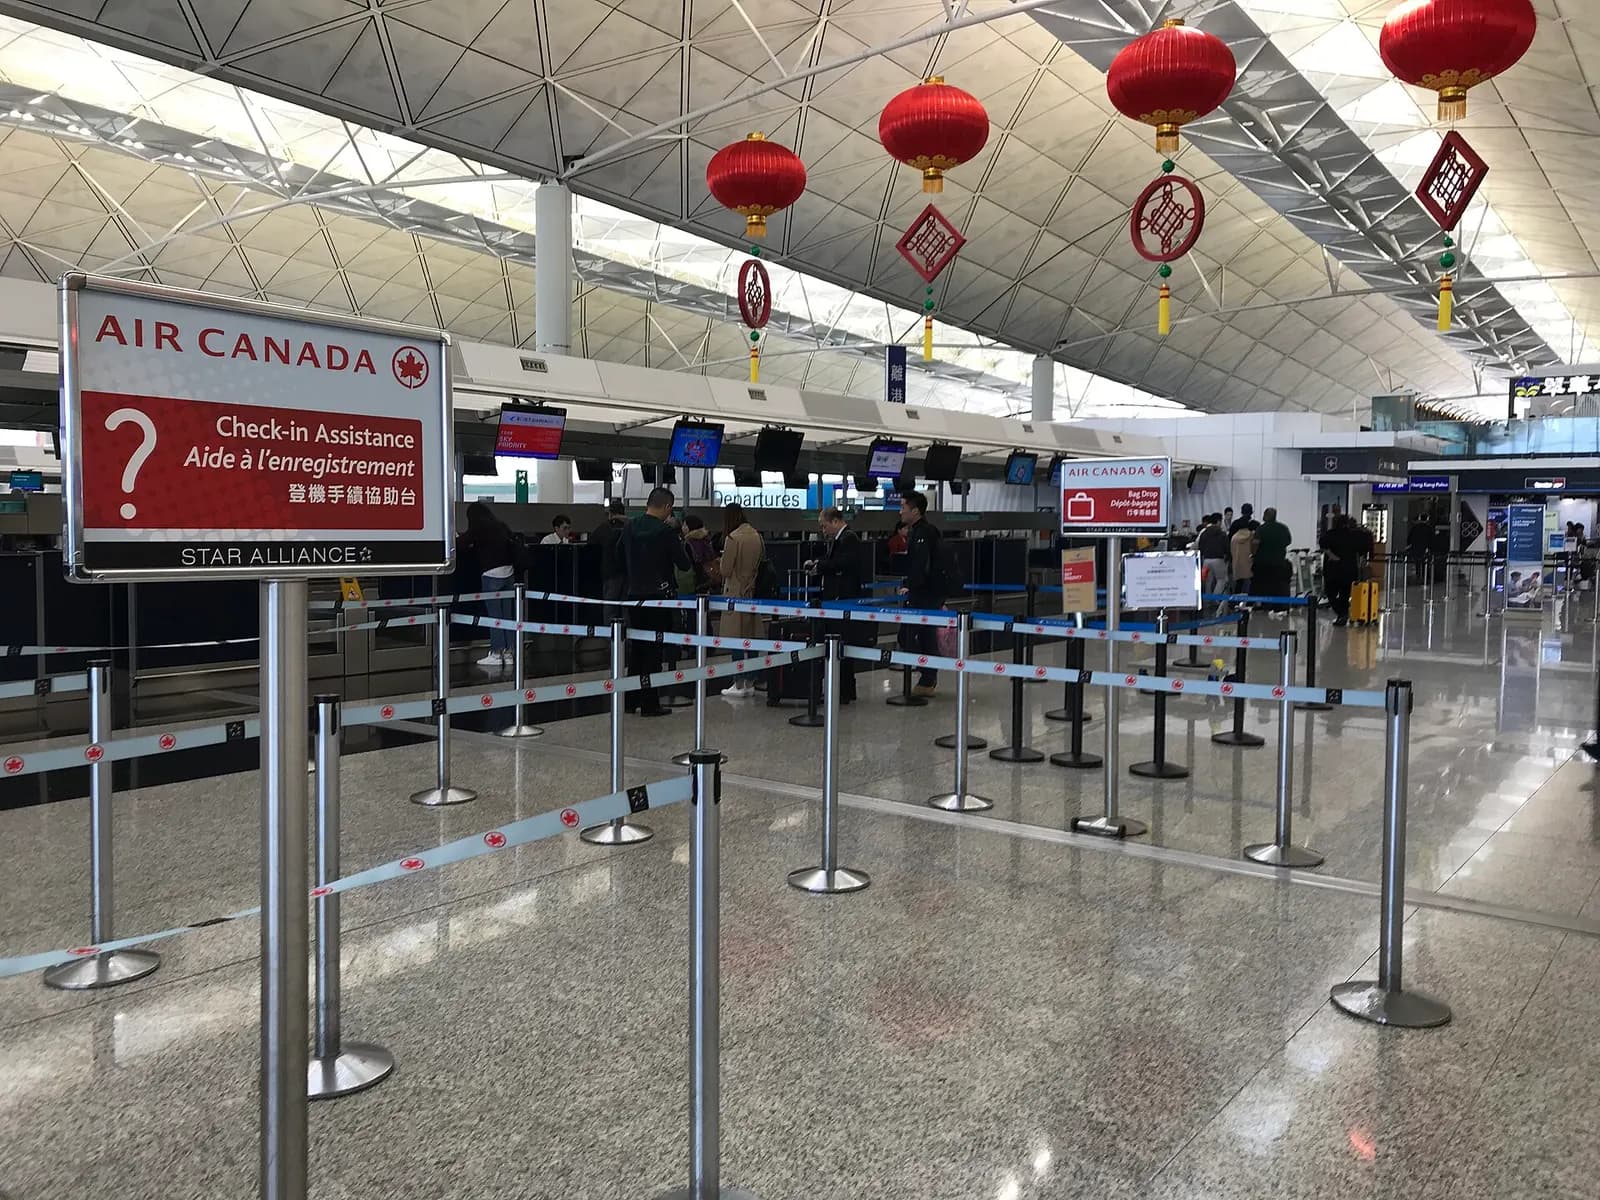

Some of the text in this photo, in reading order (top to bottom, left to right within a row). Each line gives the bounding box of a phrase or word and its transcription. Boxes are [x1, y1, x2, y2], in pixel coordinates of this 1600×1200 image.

[95, 314, 377, 375] AIR CANADA
[216, 415, 415, 449] Check-in Assistance
[184, 446, 415, 478] Aide à l'enregistrement
[1069, 466, 1145, 477] AIR CANADA
[288, 483, 416, 506] 登機手續協助台
[1128, 490, 1158, 499] Bag Drop
[181, 546, 356, 566] STAR ALLIANCE
